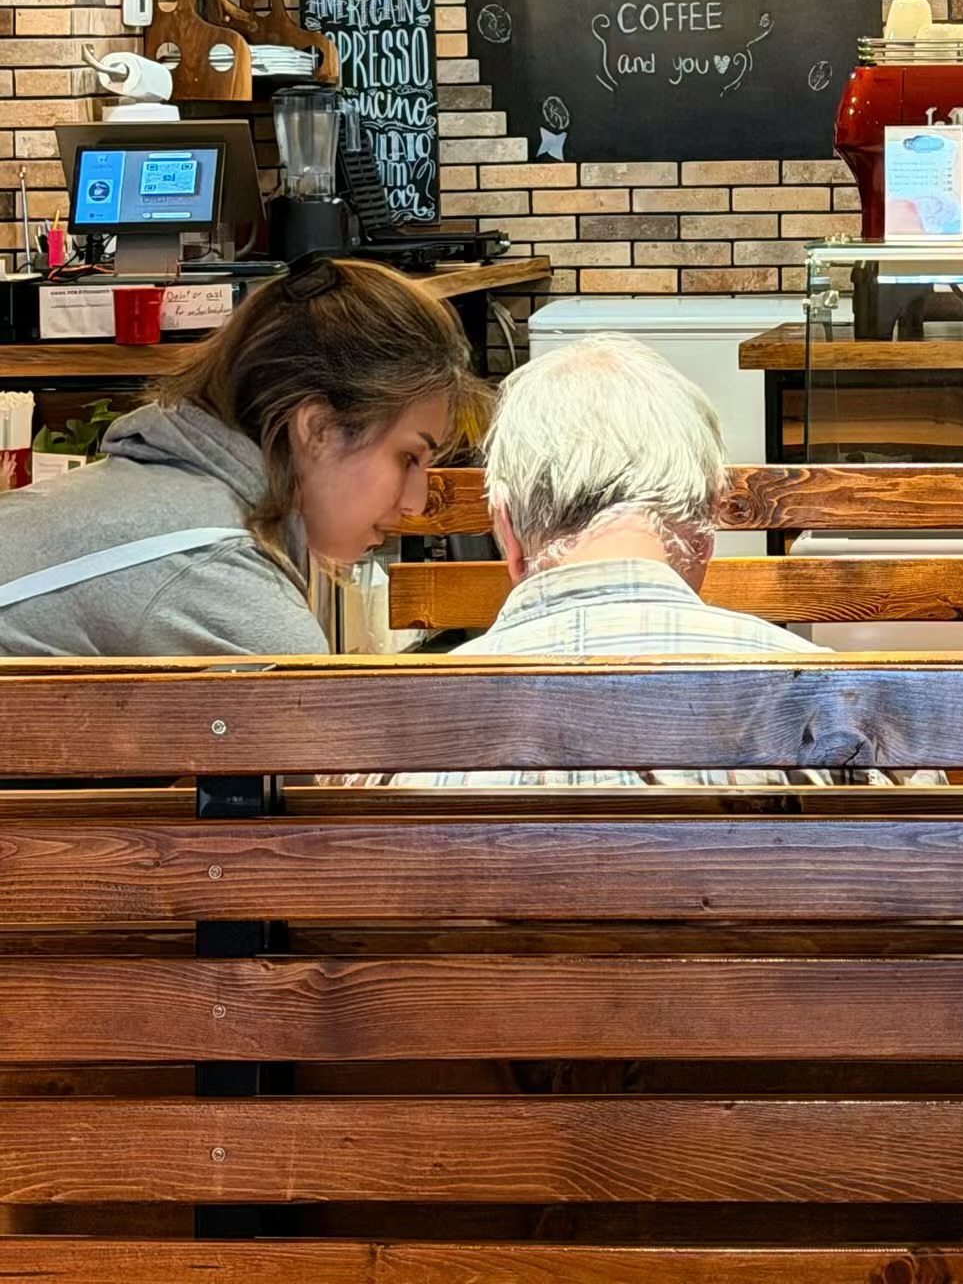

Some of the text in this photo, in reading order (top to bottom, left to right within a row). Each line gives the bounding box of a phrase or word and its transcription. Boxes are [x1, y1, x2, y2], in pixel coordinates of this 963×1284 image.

[617, 2, 724, 34] COFFEE
[325, 27, 429, 89] PRESSO
[617, 53, 709, 85] and you
